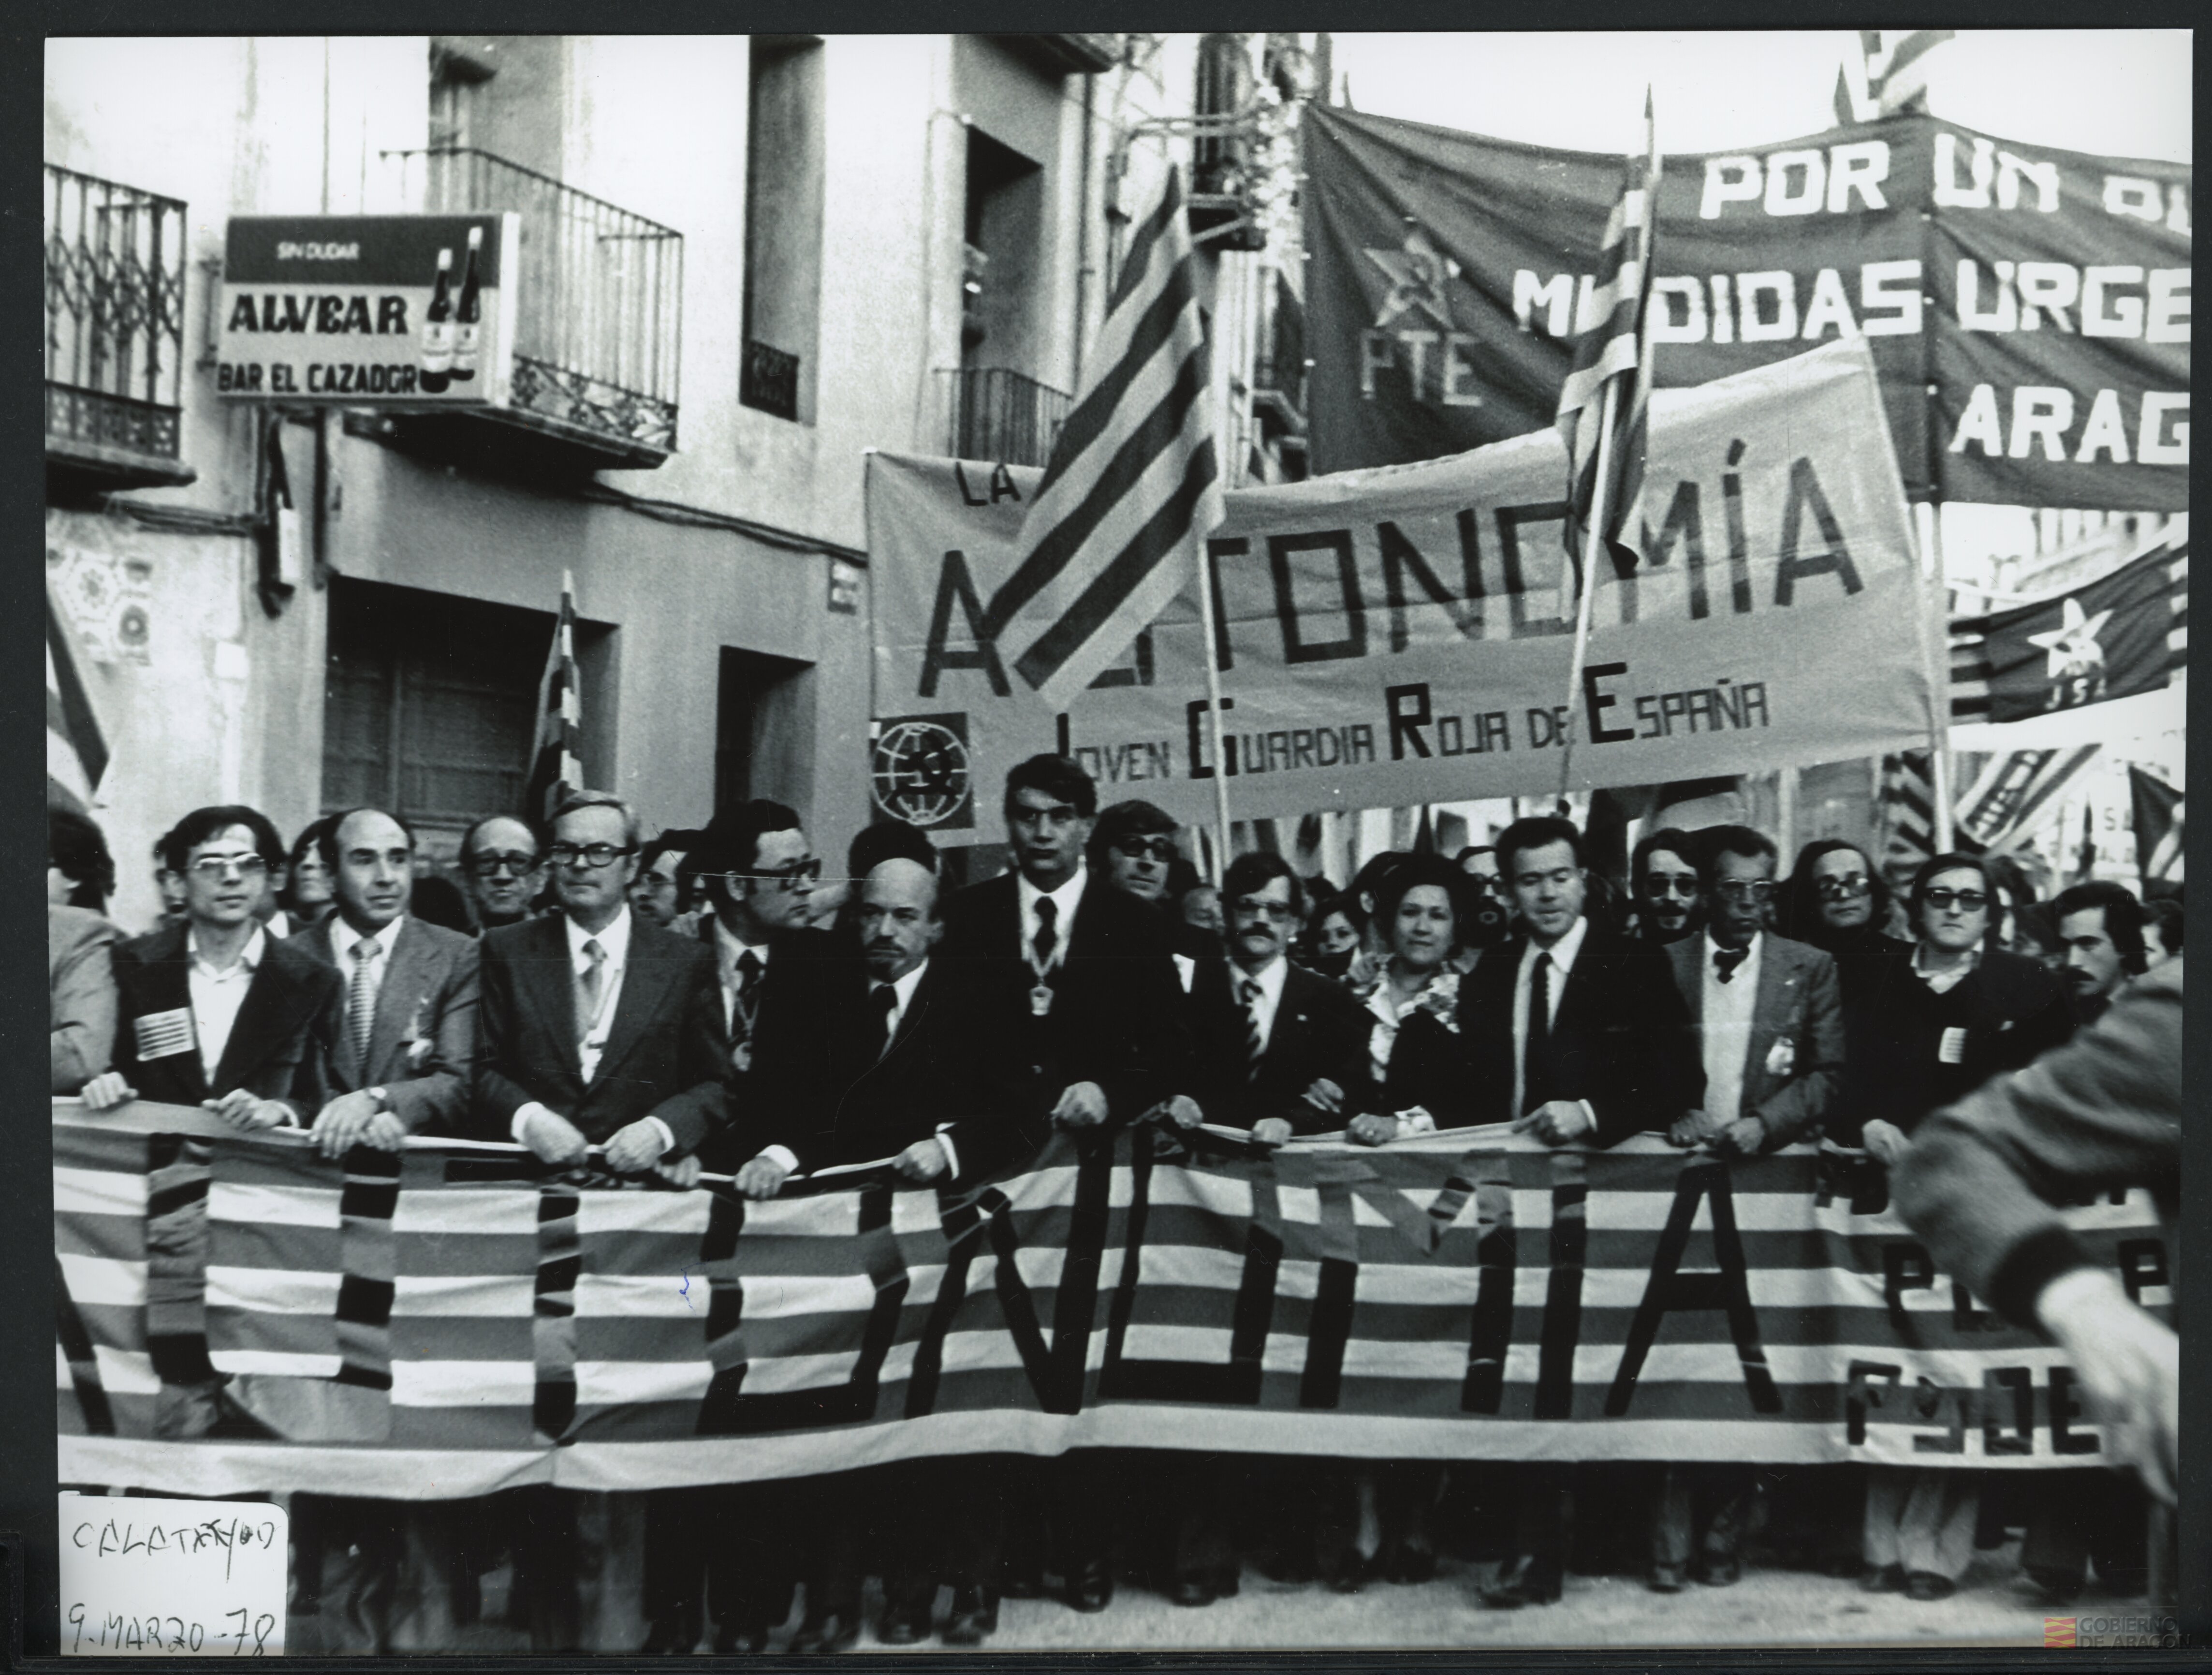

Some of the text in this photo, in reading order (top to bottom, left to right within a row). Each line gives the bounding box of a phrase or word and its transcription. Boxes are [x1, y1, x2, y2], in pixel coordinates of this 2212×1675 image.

[1699, 139, 1890, 220] POR
[1933, 132, 2060, 213] UN
[277, 241, 360, 261] SIN DUDAR
[228, 294, 409, 335] ALVEAR
[1956, 257, 2192, 342] URGE
[217, 363, 419, 394] BAR EL CAZADOR
[1360, 327, 1483, 408] PTE
[1948, 383, 2190, 465] ARAG
[954, 461, 1023, 507] LA
[919, 438, 1865, 698] ATONOMÍA
[1187, 696, 1377, 779] GUARDIA
[1385, 682, 1511, 761] ROJA
[1526, 704, 1570, 750] DE
[1581, 661, 1771, 745] ESPAÑA
